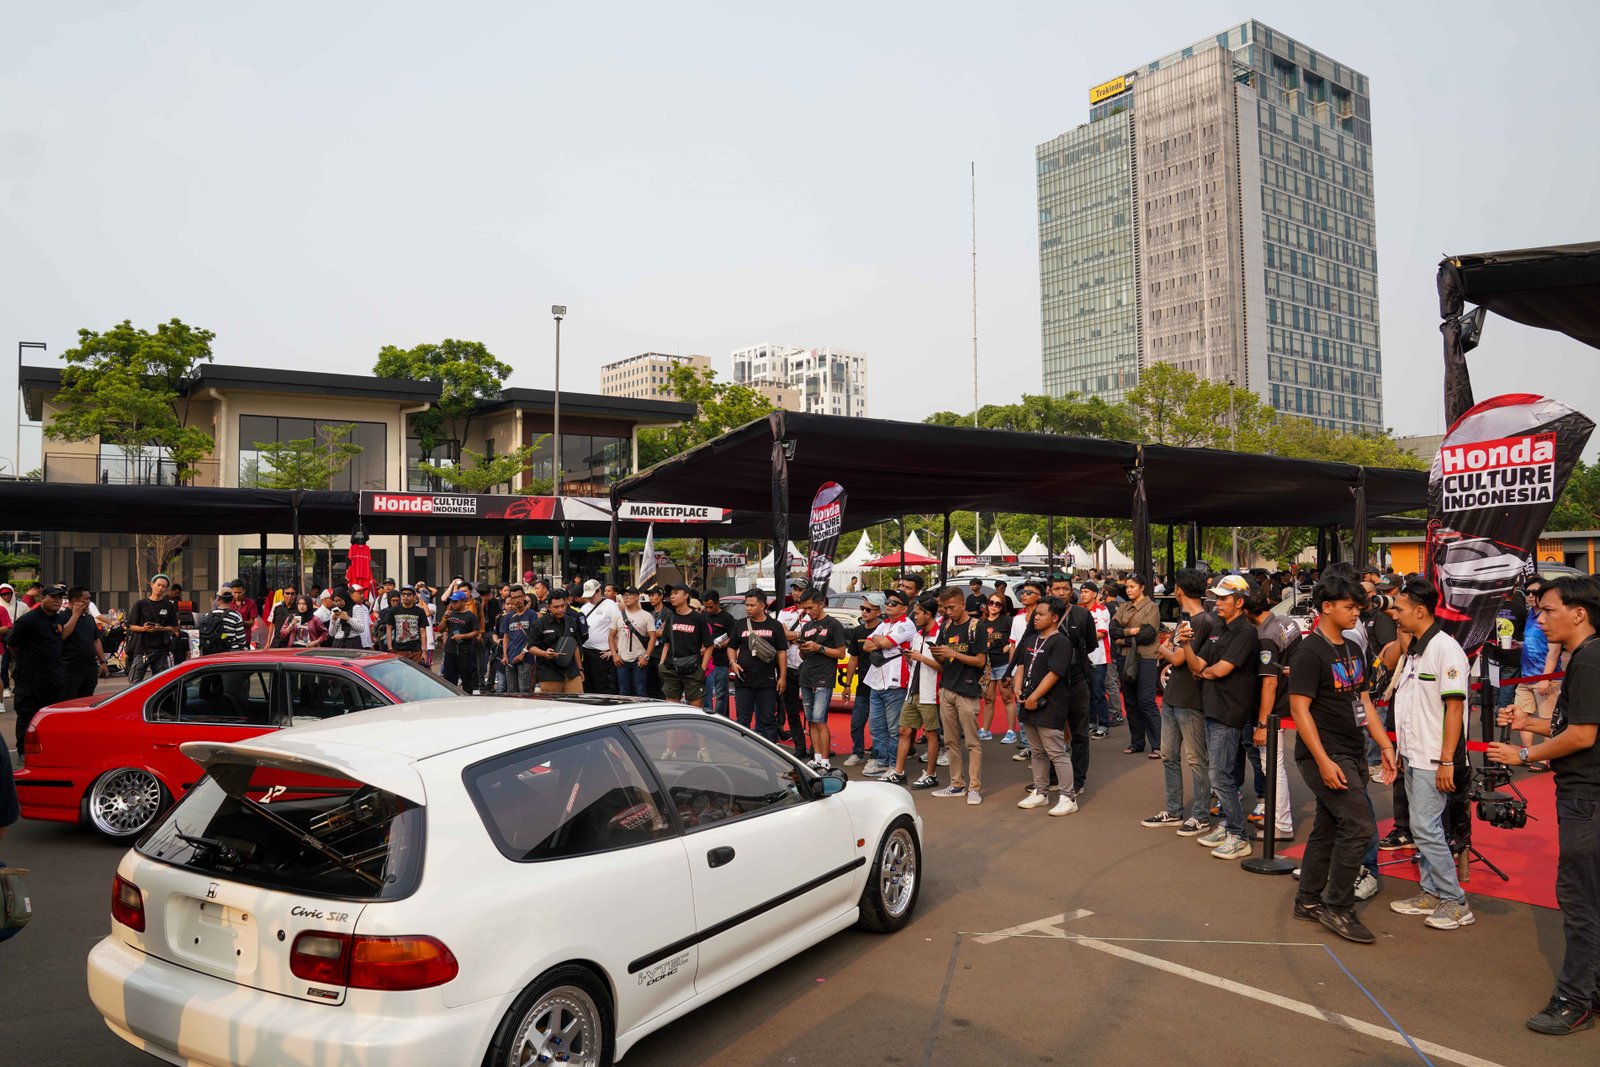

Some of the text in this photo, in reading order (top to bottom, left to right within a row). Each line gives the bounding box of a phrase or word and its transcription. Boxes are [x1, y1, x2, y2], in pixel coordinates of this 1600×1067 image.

[1096, 82, 1122, 97] Trakindo
[1442, 437, 1554, 473] Honda
[1444, 464, 1552, 494] CULTURE
[374, 496, 432, 511] Honda
[434, 497, 476, 506] CULTURE
[1444, 485, 1551, 510] INDONESIA
[630, 506, 708, 517] MARKETPLACE
[812, 503, 840, 521] Honda
[291, 905, 349, 922] Civic SiR
[647, 967, 678, 987] DOHC
